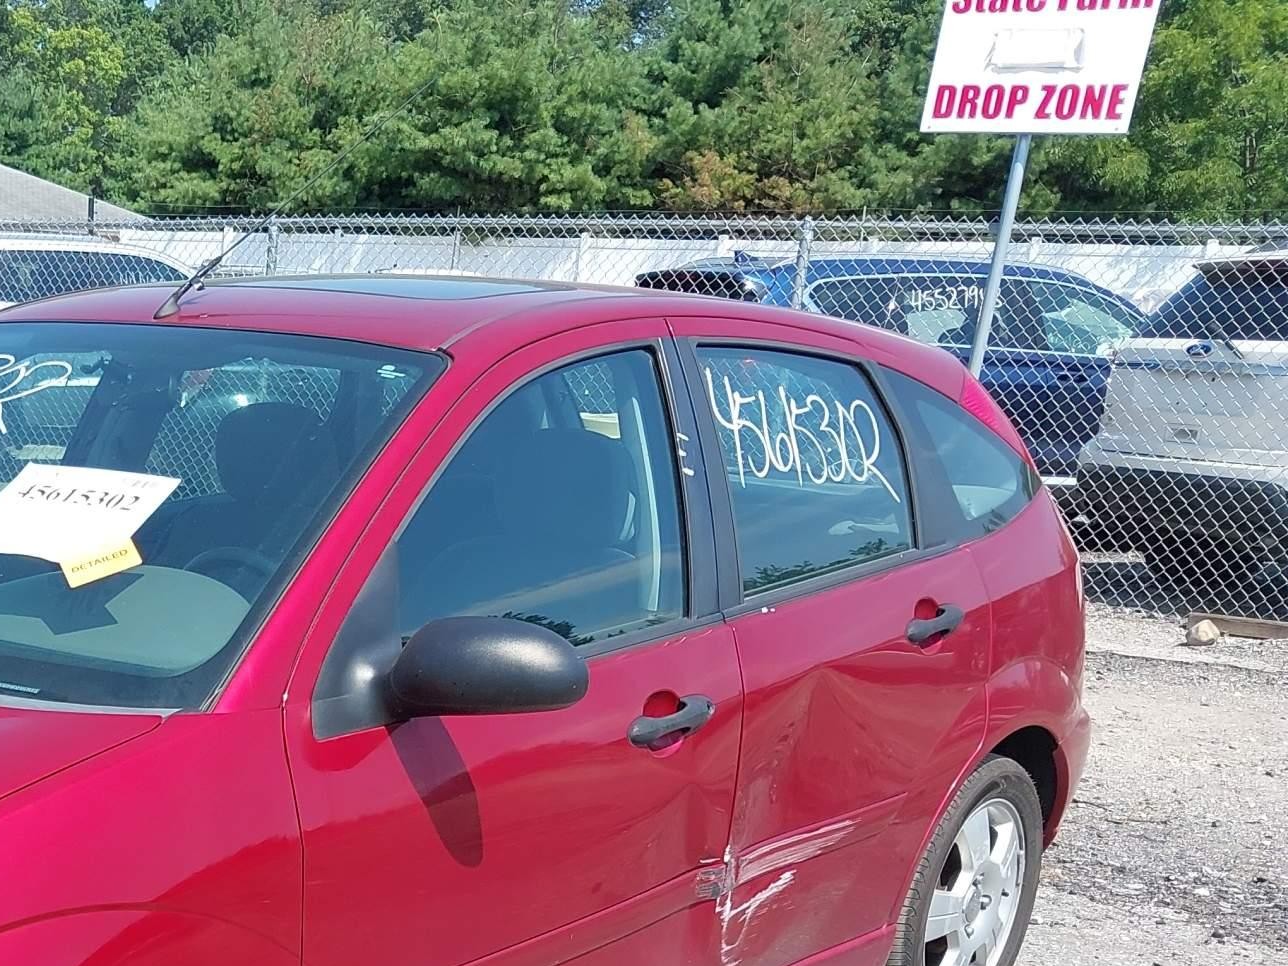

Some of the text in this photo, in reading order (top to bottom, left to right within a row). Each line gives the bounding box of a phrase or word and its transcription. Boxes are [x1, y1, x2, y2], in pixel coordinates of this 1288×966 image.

[932, 83, 1129, 120] DROP ZONE
[705, 367, 901, 503] 45615302
[17, 483, 141, 511] 45615302
[70, 548, 129, 574] DETAILED
